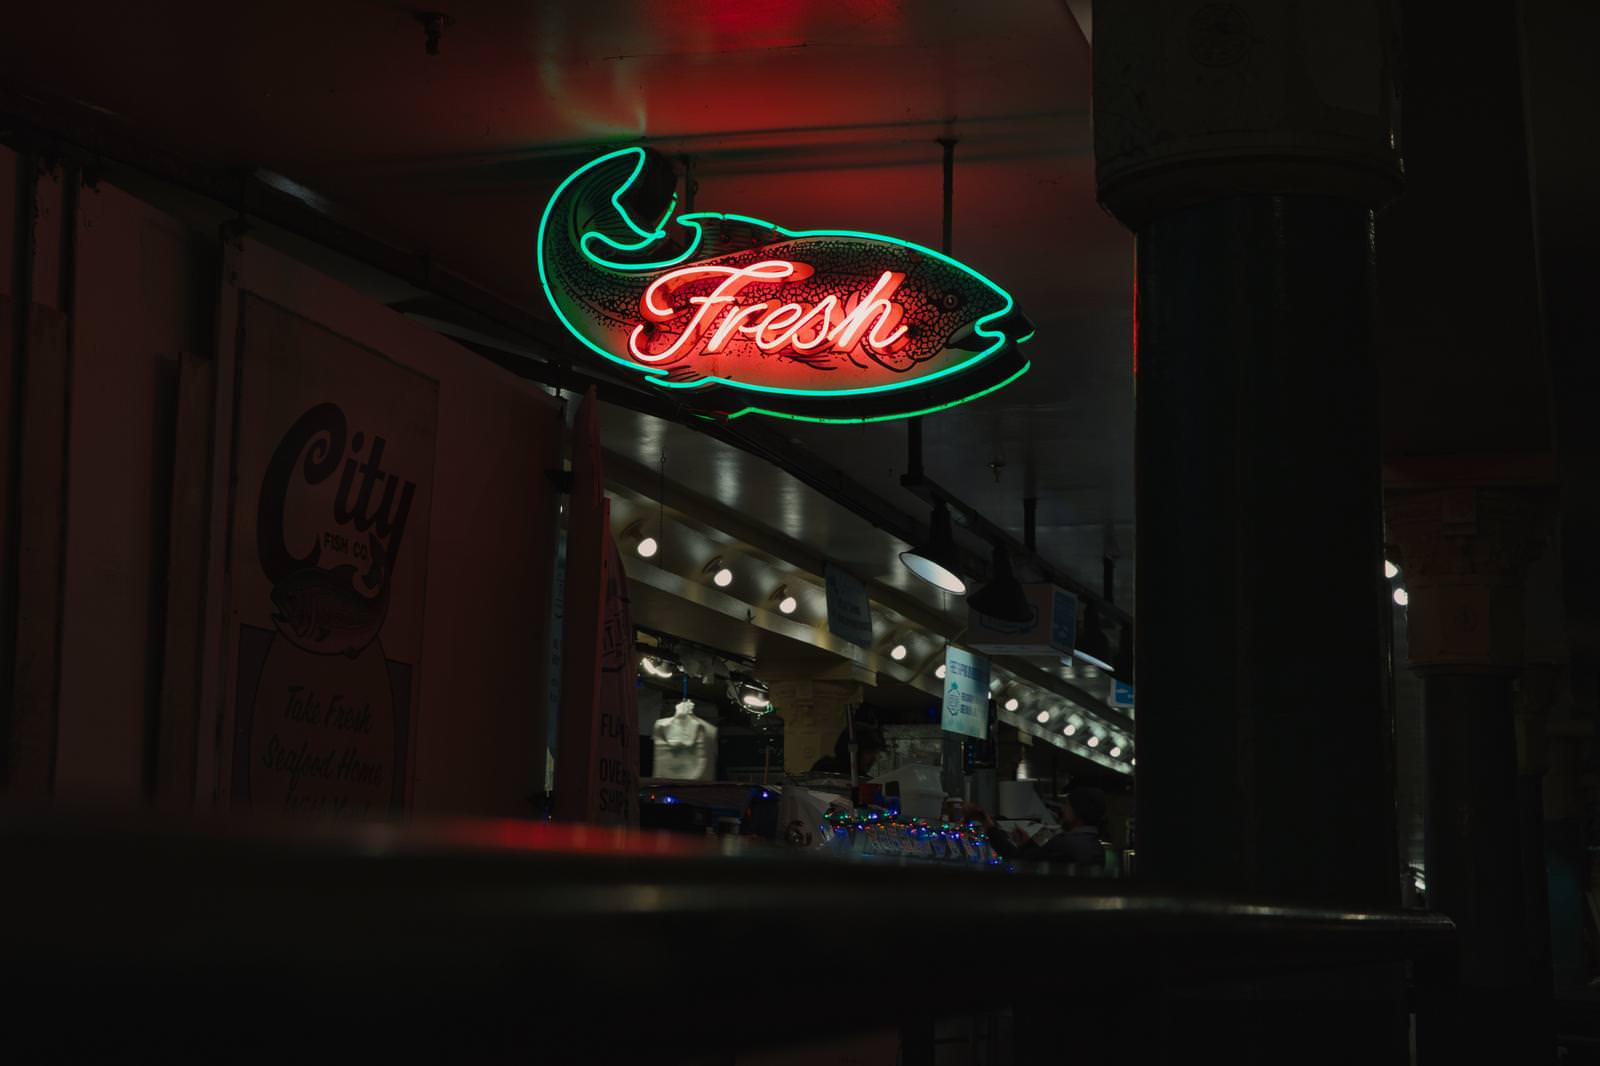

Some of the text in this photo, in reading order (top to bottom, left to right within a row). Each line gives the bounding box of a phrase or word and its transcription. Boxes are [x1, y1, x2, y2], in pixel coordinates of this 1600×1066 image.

[627, 259, 908, 364] Fresh
[257, 402, 416, 584] City
[323, 531, 349, 555] FISH
[284, 685, 372, 735] Take Fresh
[261, 734, 385, 791] Seafood Home
